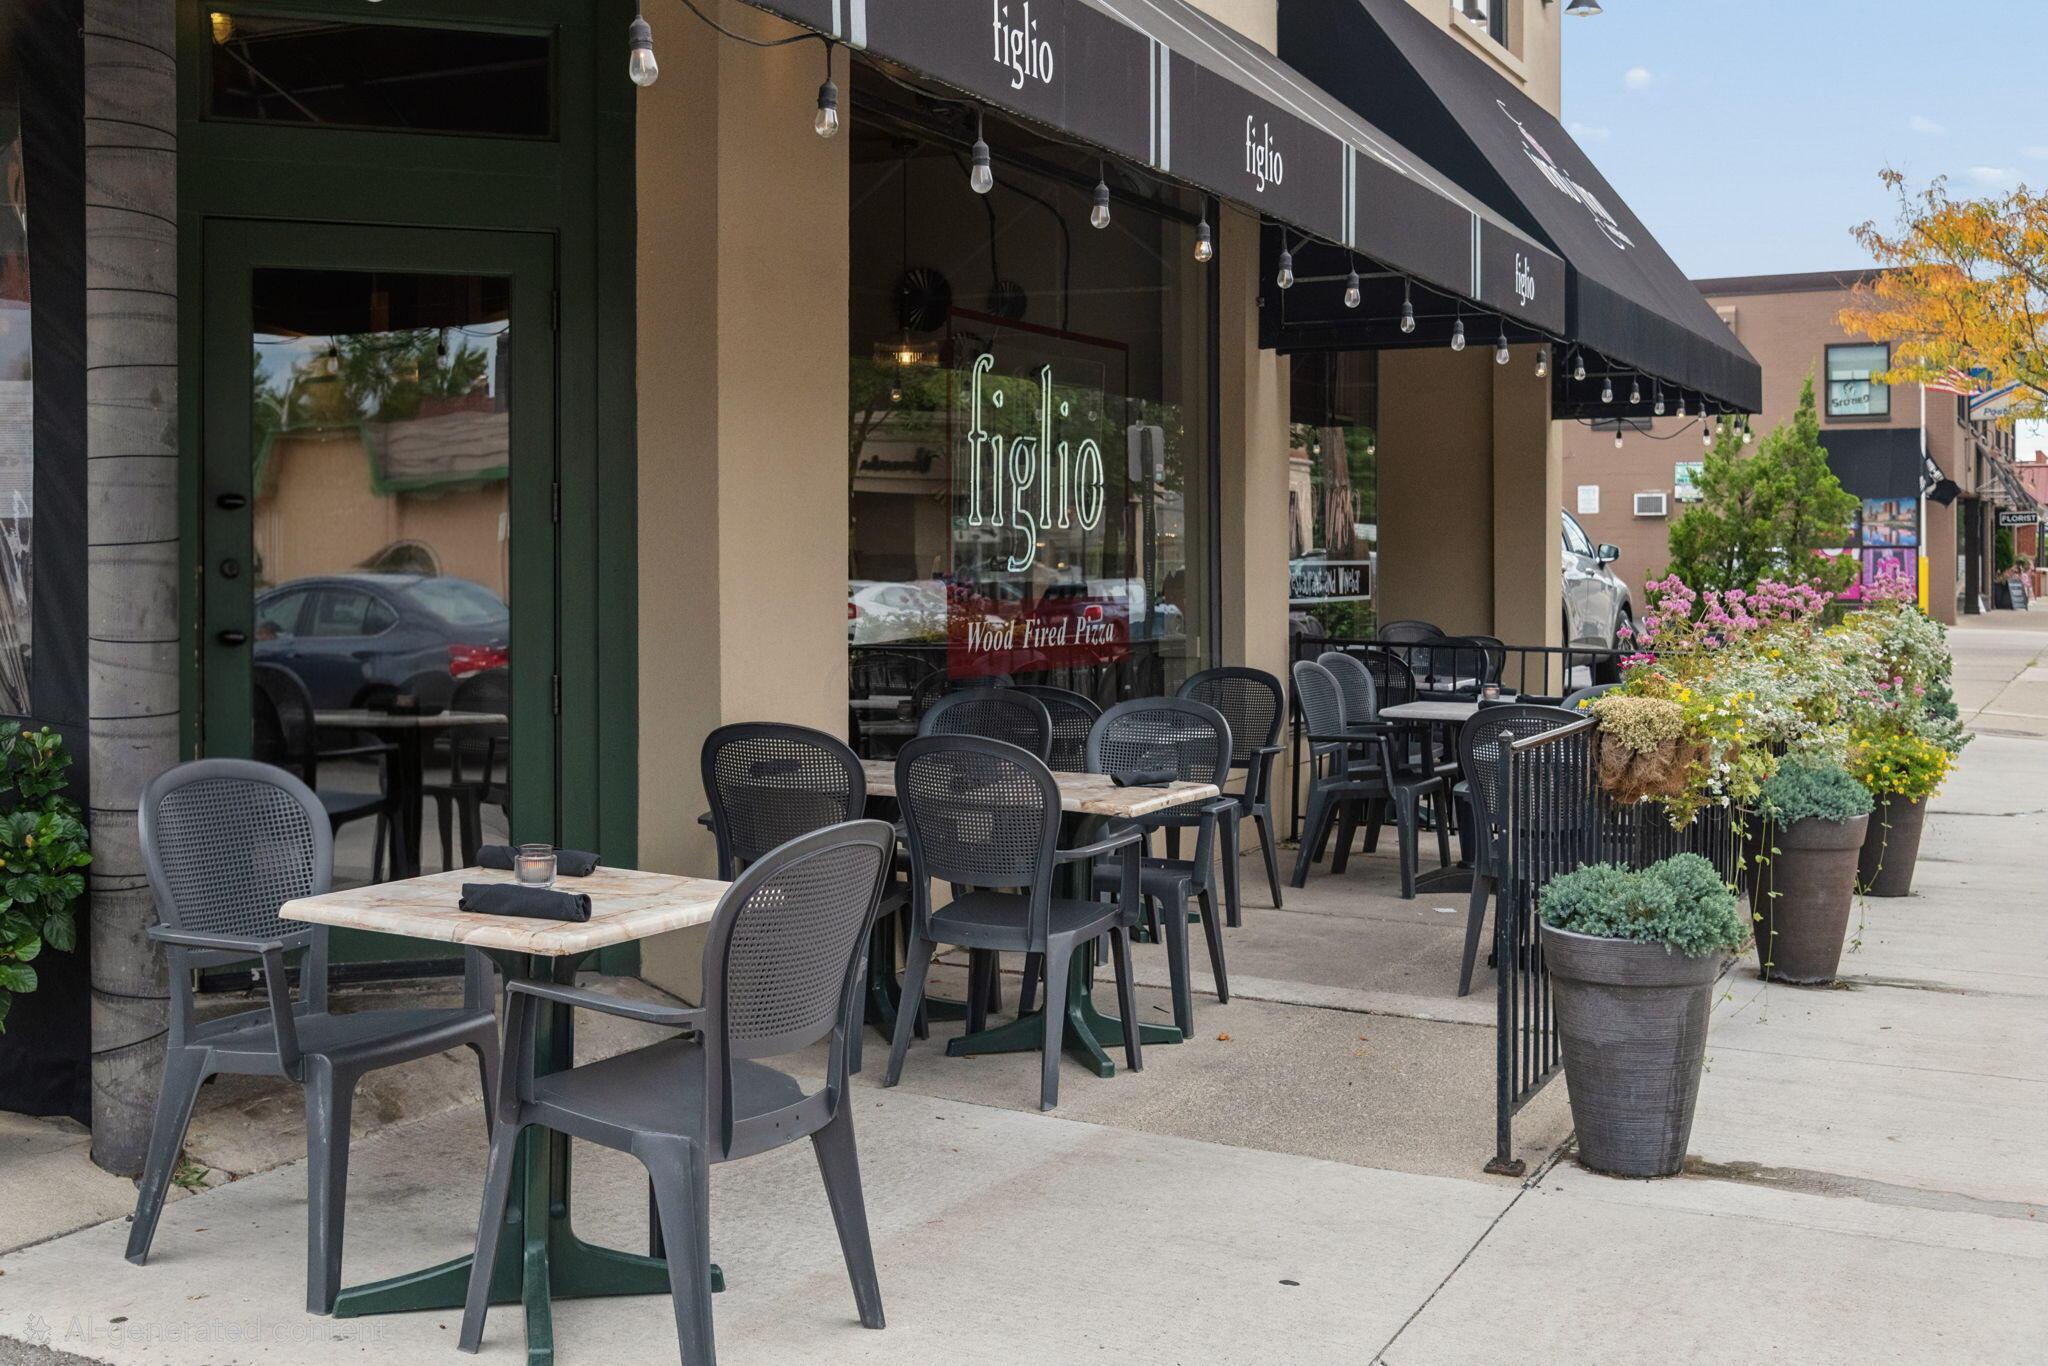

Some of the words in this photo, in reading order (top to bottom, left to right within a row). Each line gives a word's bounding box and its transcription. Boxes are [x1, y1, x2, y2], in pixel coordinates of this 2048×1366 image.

[992, 0, 1054, 90] figlio
[1246, 114, 1283, 192] figlio
[1515, 252, 1535, 306] figlio
[968, 353, 1104, 572] figlio
[2001, 514, 2036, 523] FLORIST
[967, 618, 1016, 653] Wood
[1022, 616, 1068, 649] Fired
[1073, 615, 1115, 645] Pizza
